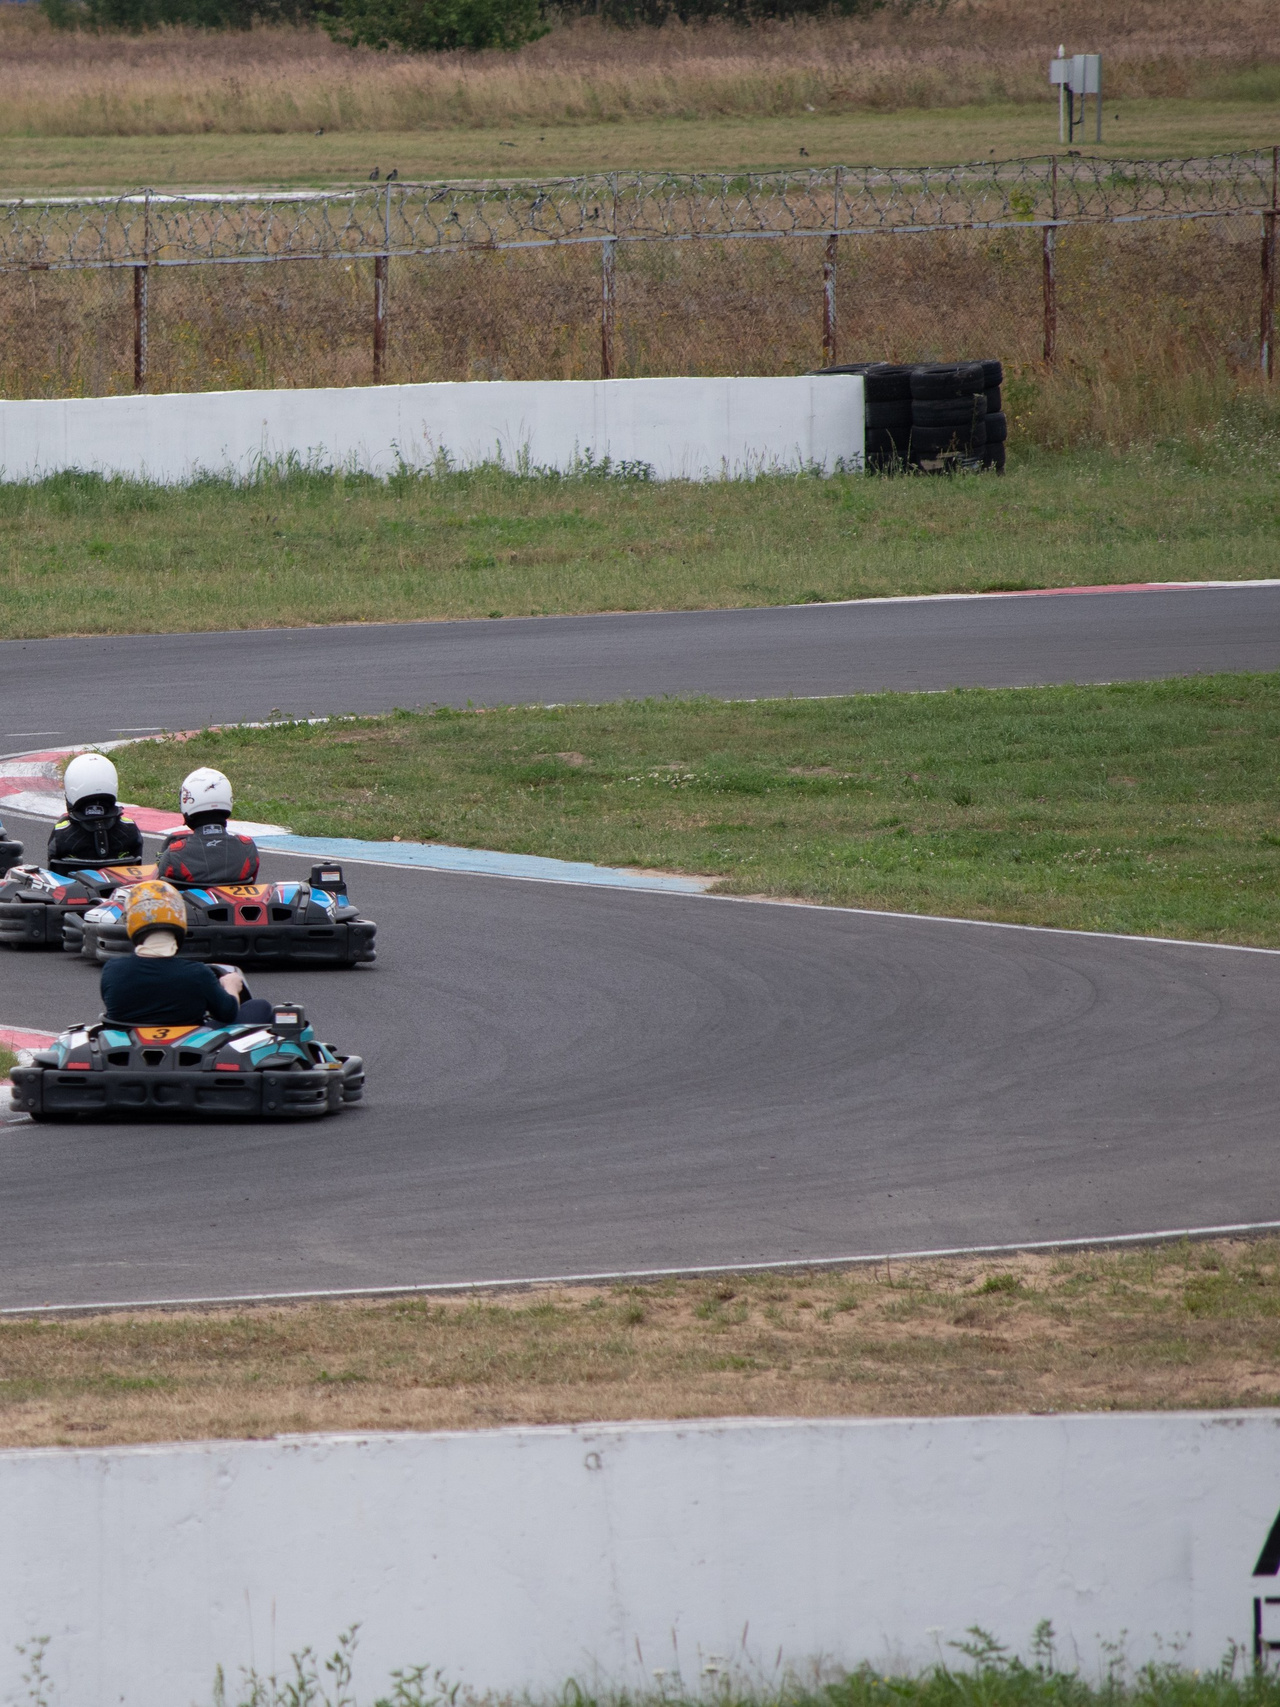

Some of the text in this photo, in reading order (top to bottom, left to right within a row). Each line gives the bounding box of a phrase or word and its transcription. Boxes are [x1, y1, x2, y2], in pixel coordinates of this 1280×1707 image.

[126, 867, 143, 876] 6
[229, 885, 260, 896] 20
[152, 1028, 170, 1039] 3
